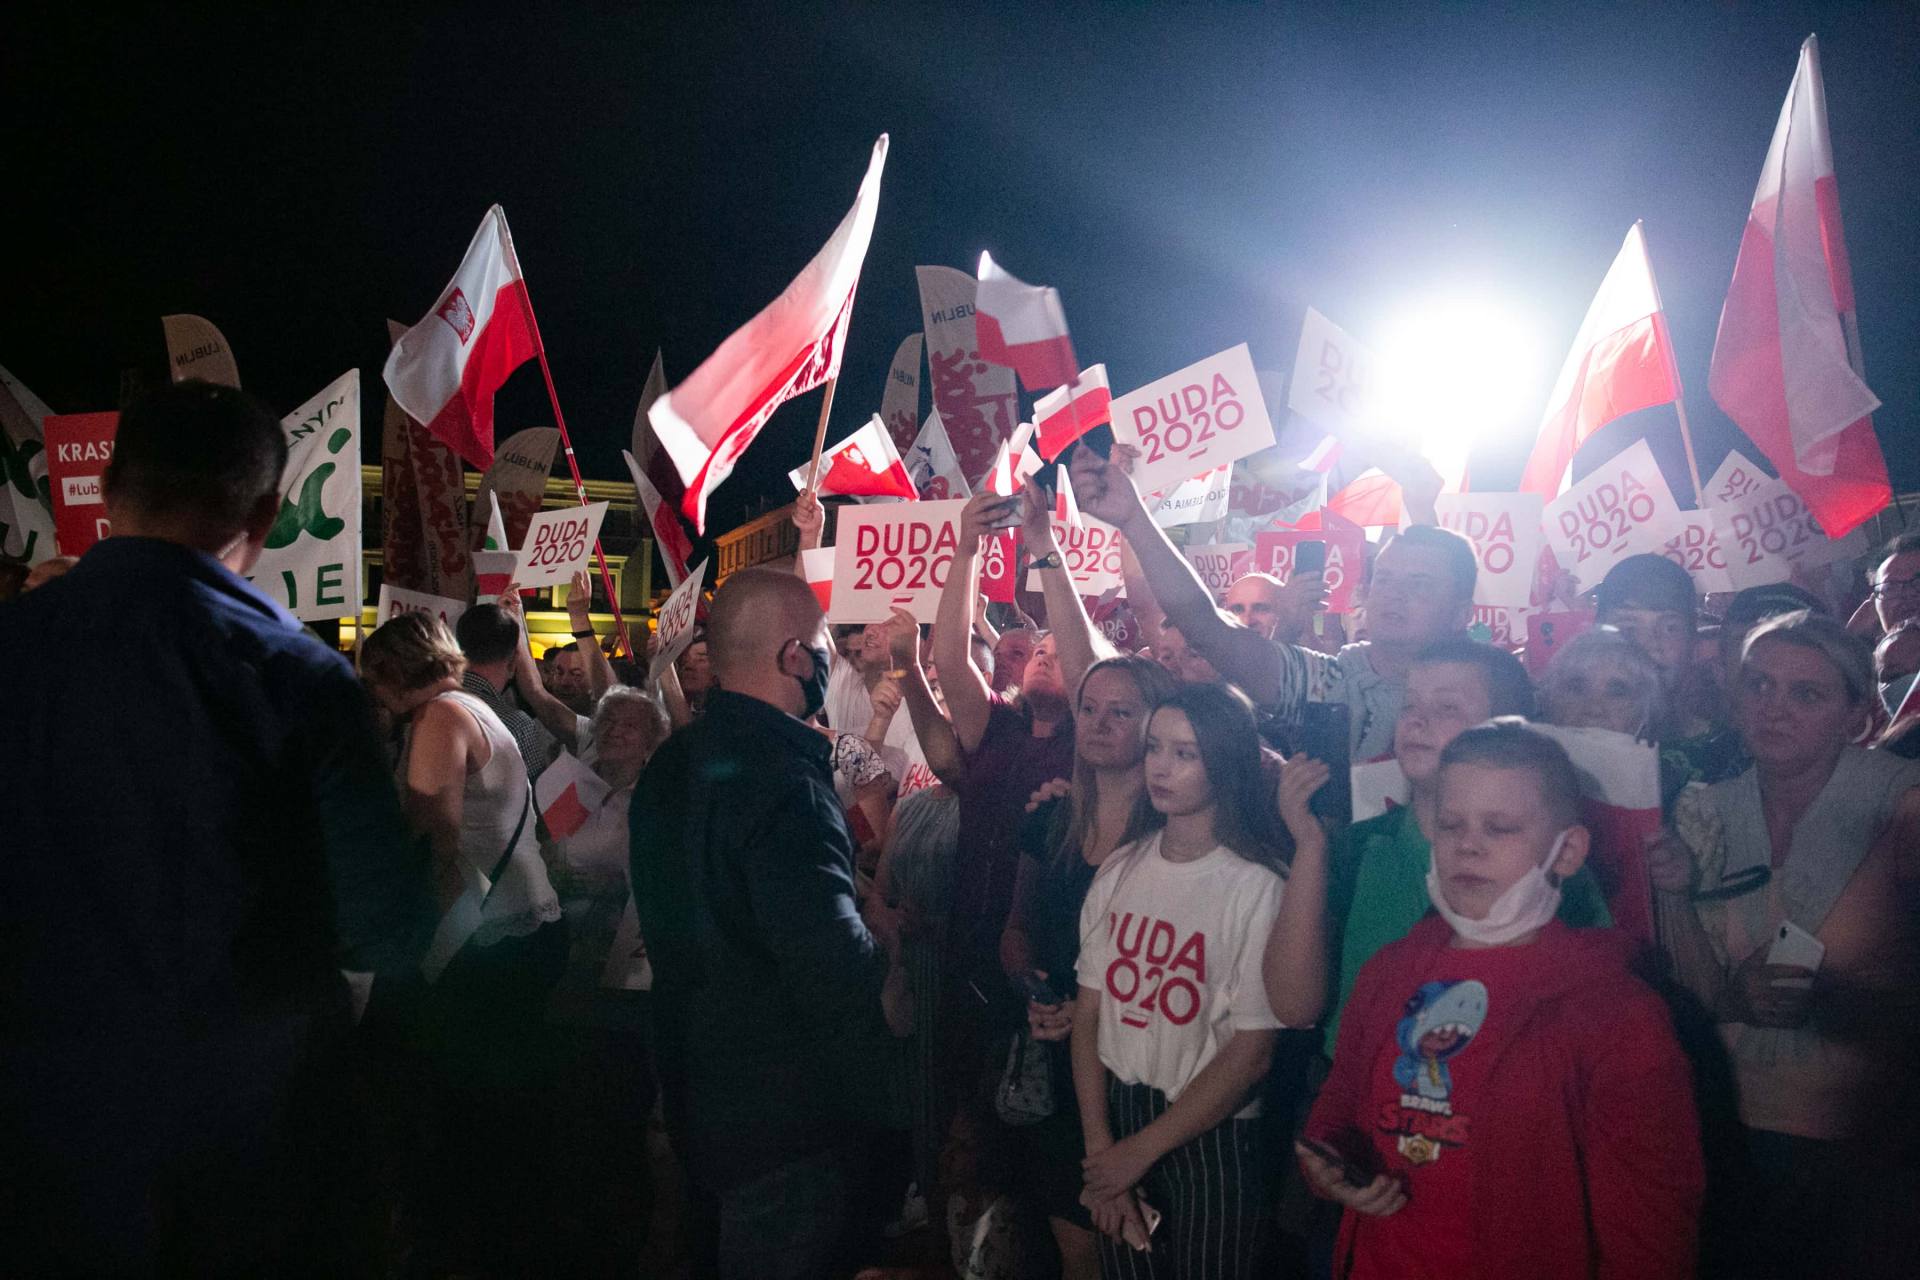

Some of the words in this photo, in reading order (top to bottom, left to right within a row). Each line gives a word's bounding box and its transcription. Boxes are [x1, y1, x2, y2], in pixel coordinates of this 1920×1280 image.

[1132, 372, 1237, 437] DUDA
[1142, 399, 1244, 465] 2020
[504, 452, 547, 473] LUBLIN
[69, 482, 100, 496] #Lub
[1558, 470, 1645, 539] DUDA
[535, 518, 588, 546] DUDA
[856, 520, 958, 557] DUDA
[1570, 493, 1655, 564] 2020
[1731, 494, 1798, 541] DUD
[528, 540, 585, 567] 2020
[1197, 554, 1232, 572] DUD
[1272, 546, 1344, 568] DA
[660, 581, 694, 631] DUDA
[1109, 911, 1205, 984] UDA
